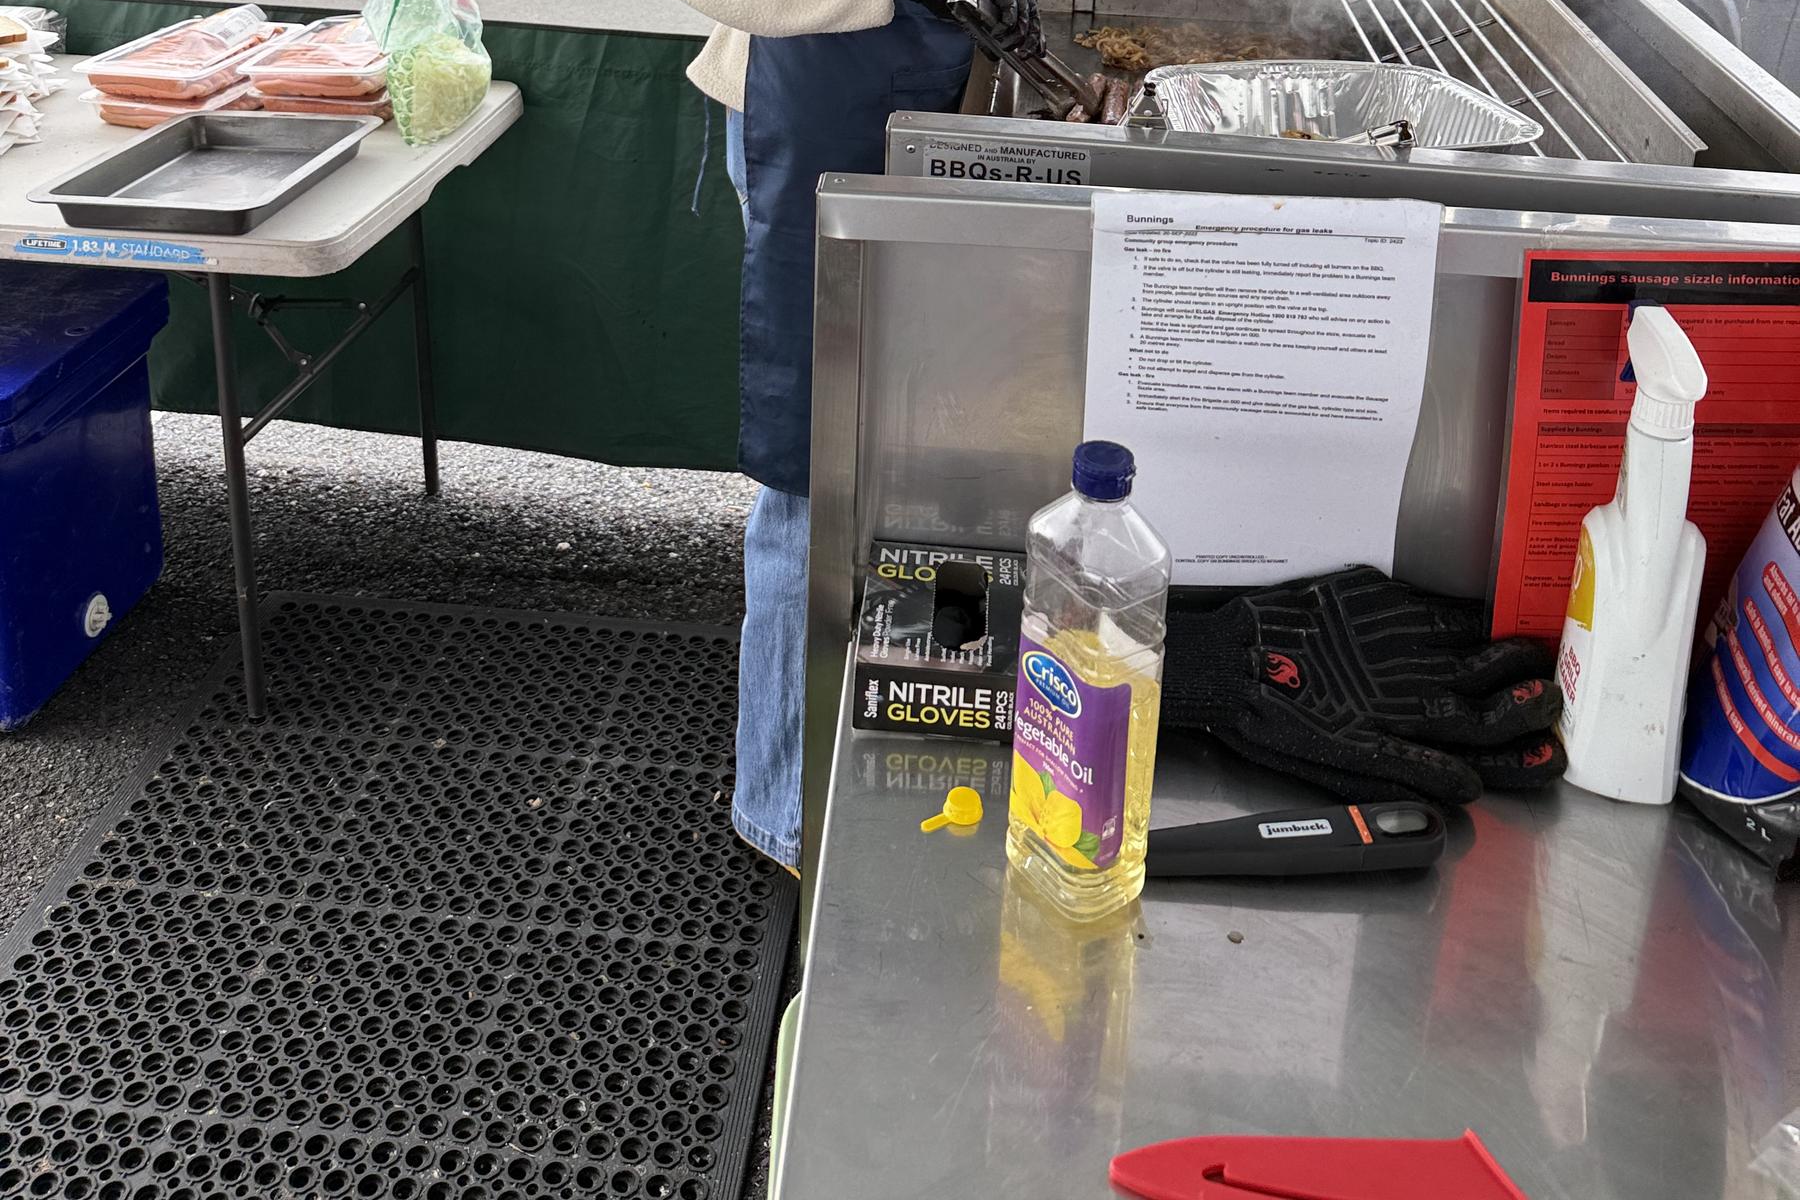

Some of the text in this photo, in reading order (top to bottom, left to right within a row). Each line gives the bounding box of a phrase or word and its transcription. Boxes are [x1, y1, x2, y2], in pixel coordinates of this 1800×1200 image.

[986, 156, 1025, 164] AUSTRALIA
[1000, 146, 1086, 161] MANUFACTURED
[930, 159, 1081, 186] BBQs-R-US
[1127, 215, 1174, 224] Bunnings
[26, 240, 65, 248] LIFETIME
[72, 240, 190, 259] 1.83 M STANDARD
[1551, 272, 1616, 285] Bunnings
[1620, 275, 1680, 286] sausage
[1684, 274, 1724, 284] sizzle
[1000, 558, 1012, 573] PCS
[1000, 573, 1012, 585] 24
[873, 622, 884, 637] Duty
[870, 636, 882, 658] Heavy
[1568, 646, 1580, 676] BBQ
[1028, 656, 1077, 706] Crisco
[1035, 678, 1060, 699] PREMIUM
[864, 679, 880, 718] Saniflex
[888, 680, 992, 710] NITRILE
[1748, 680, 1768, 712] derived
[887, 703, 990, 729] GLOVES
[994, 690, 1008, 730] 24 PCS
[1029, 698, 1074, 742] 100% PURE
[1024, 707, 1075, 756] AUSTRALIAN
[1730, 711, 1744, 734] easy
[1071, 760, 1094, 785] Oil
[1266, 822, 1326, 836] jumbuck
